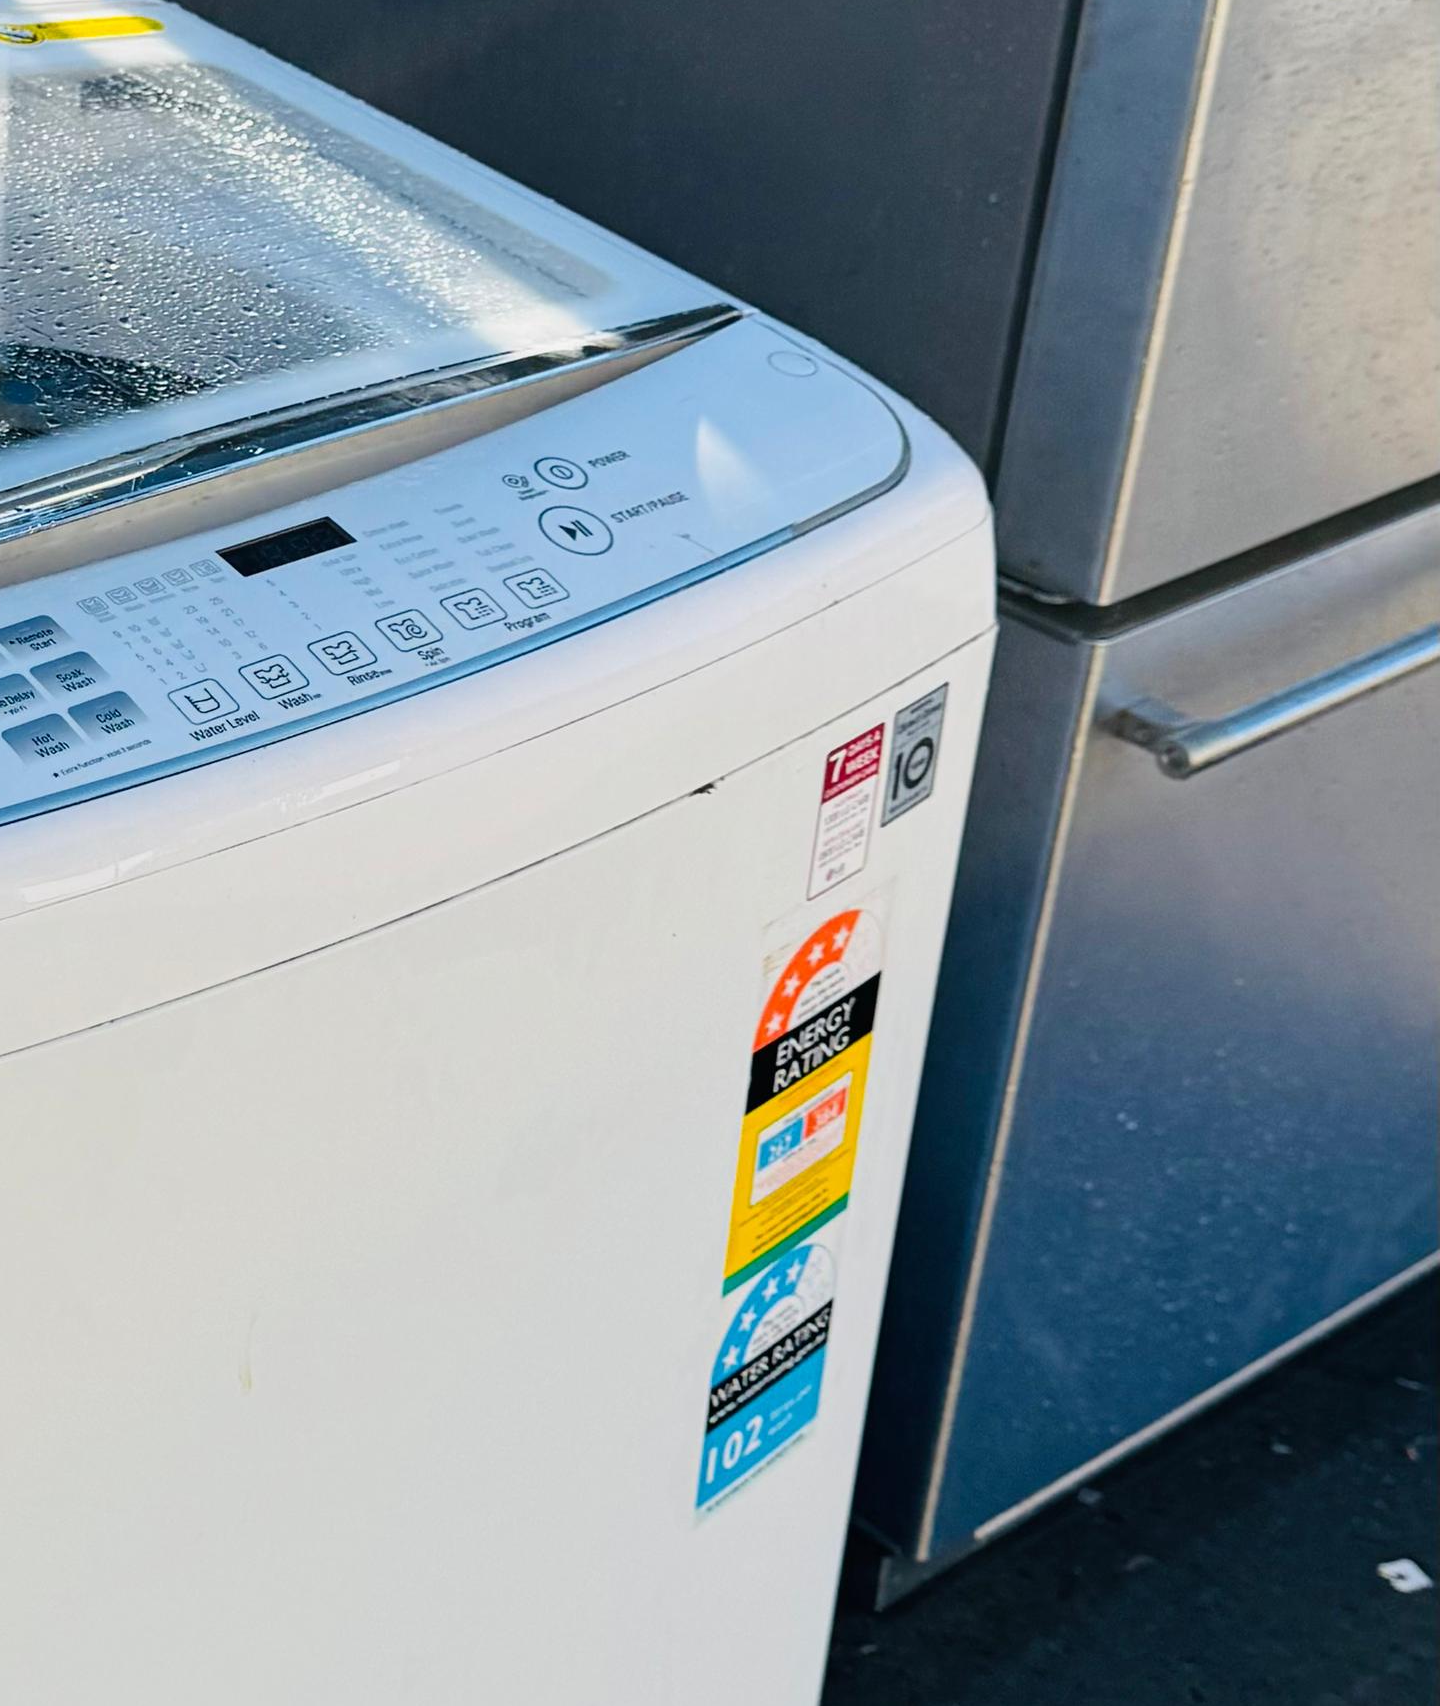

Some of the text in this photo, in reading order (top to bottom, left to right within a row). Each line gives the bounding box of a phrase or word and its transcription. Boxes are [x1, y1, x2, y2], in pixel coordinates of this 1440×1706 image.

[588, 450, 632, 468] POWER
[503, 612, 552, 632] Program
[29, 638, 57, 651] Start
[417, 647, 445, 661] Spin
[56, 668, 86, 683] Soak
[62, 676, 97, 692] Wash
[347, 669, 381, 687] Rinse
[6, 689, 36, 706] Delay
[277, 693, 315, 710] Wash
[95, 708, 123, 723] Cold
[101, 717, 136, 735] Wash
[189, 710, 260, 742] Water Level
[31, 733, 55, 747] Hot
[34, 741, 71, 758] Wash
[828, 747, 848, 784] 7
[892, 737, 934, 801] 10
[775, 997, 856, 1067] ENERGY
[773, 1025, 851, 1093] RATING
[710, 1355, 770, 1408] WATER
[771, 1307, 831, 1366] RATING
[706, 1414, 764, 1484] 102
